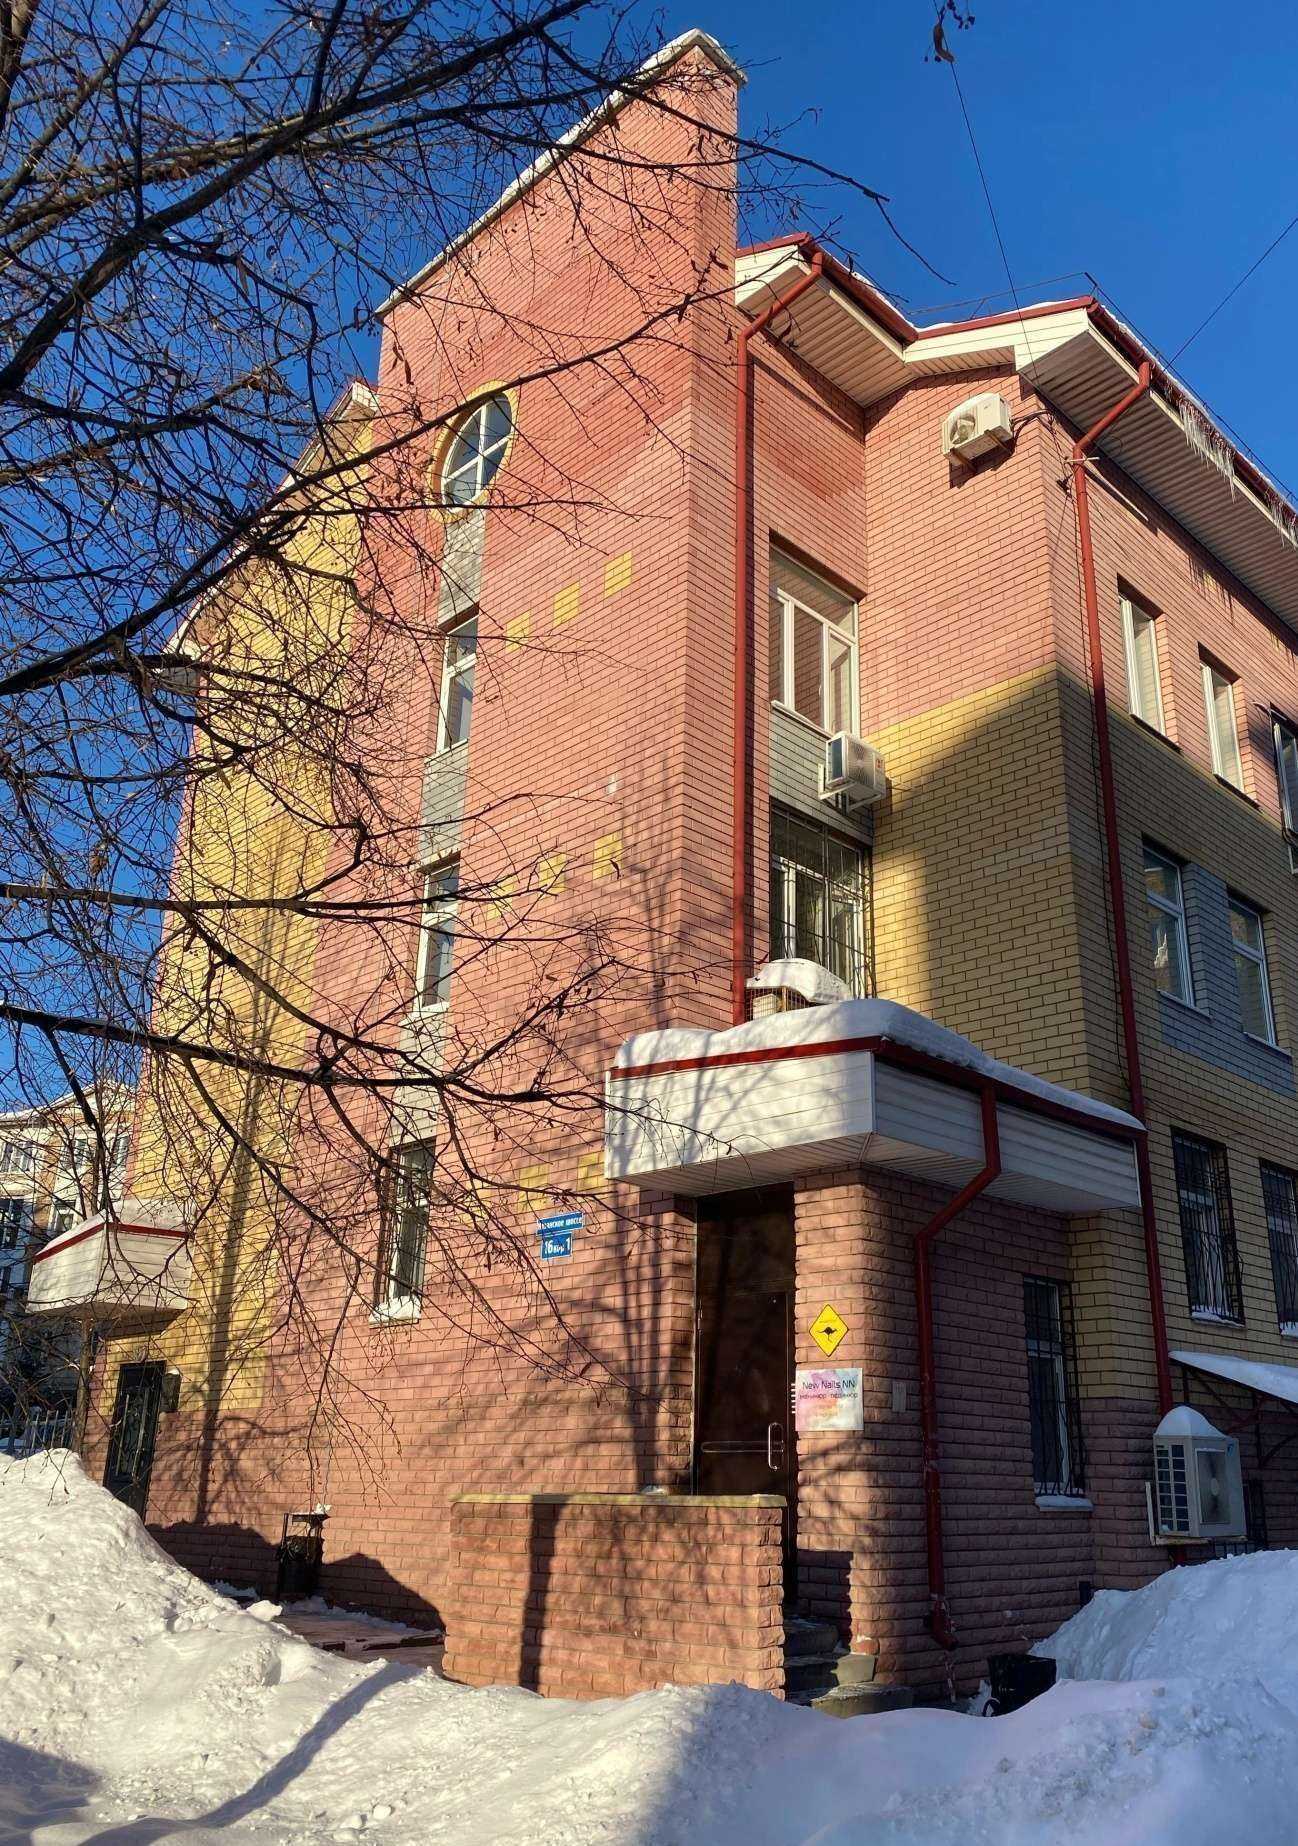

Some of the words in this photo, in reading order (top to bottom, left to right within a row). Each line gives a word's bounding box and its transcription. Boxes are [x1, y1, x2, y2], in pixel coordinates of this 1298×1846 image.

[803, 1382, 820, 1390] New
[822, 1380, 841, 1389] Nails
[842, 1380, 856, 1388] NN
